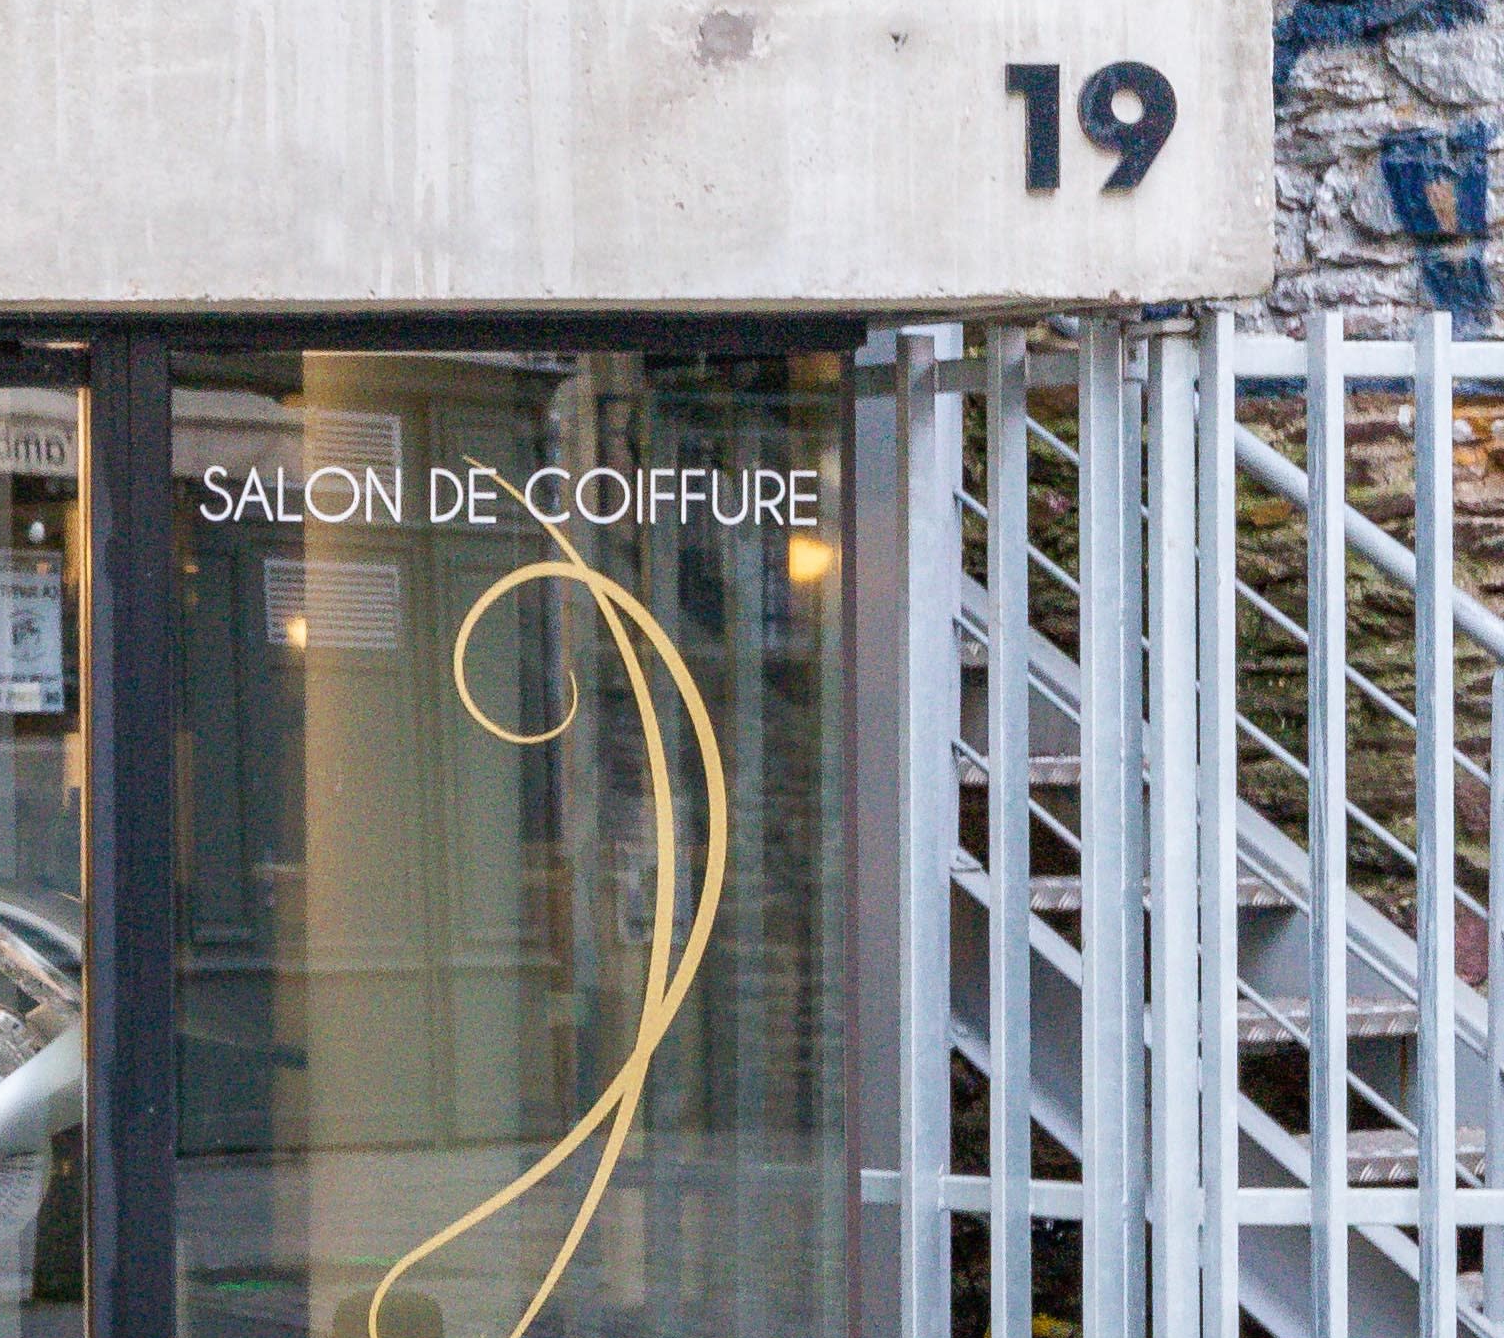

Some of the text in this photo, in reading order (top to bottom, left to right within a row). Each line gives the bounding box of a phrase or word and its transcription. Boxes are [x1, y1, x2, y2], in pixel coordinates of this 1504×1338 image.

[1004, 60, 1178, 193] 19
[198, 464, 819, 527] SALON DE COIFFURE
